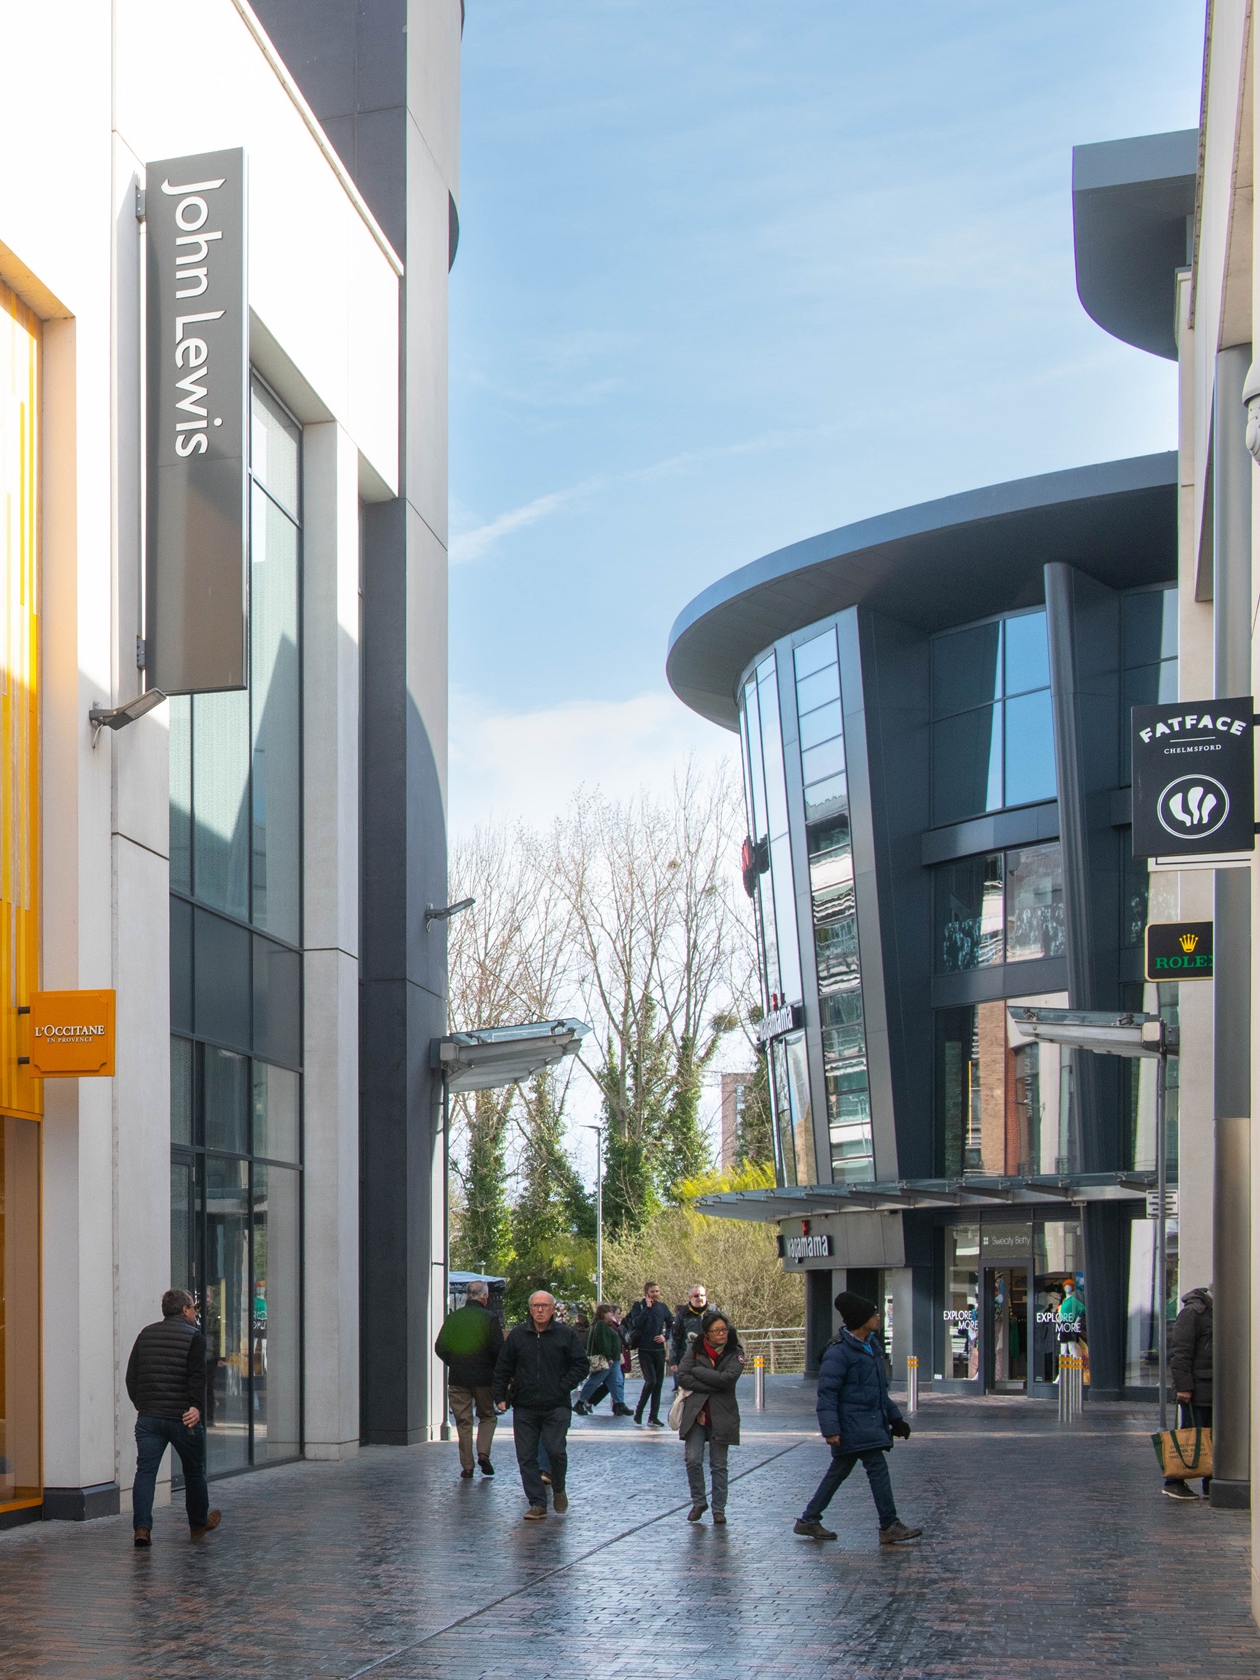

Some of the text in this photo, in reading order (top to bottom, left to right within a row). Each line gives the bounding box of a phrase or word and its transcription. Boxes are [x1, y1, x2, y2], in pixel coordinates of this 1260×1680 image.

[161, 178, 227, 458] John Lewis
[1139, 714, 1247, 744] FATFACE
[1163, 744, 1222, 755] CHELMSFORD
[992, 1236, 1031, 1246] Sweaty Betty
[943, 1310, 973, 1320] EXPLORE
[1036, 1312, 1074, 1322] EXPLORE
[958, 1320, 979, 1329] MORE
[1055, 1322, 1081, 1333] MORE
